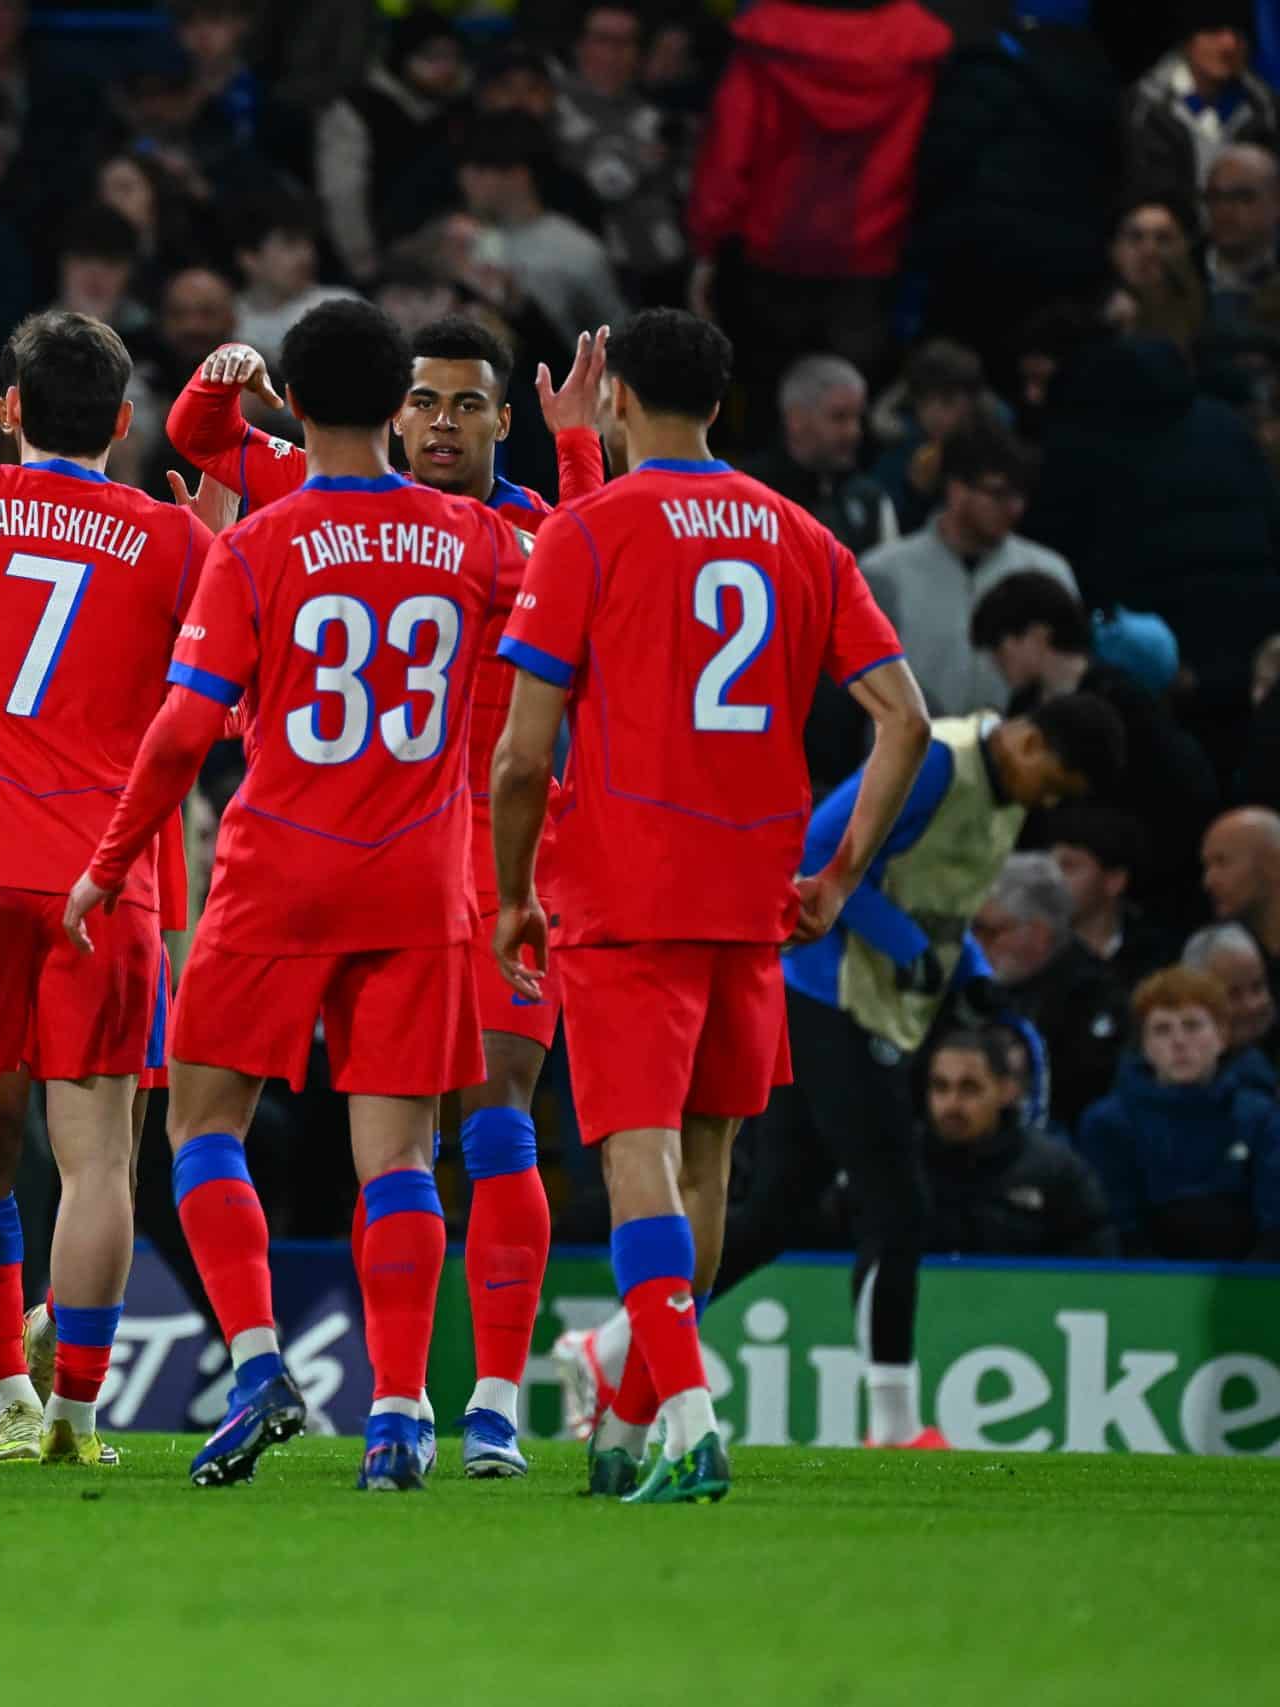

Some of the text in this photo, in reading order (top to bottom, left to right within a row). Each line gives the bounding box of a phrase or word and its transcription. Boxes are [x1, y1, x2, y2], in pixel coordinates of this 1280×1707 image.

[291, 520, 465, 576] ZAÏRE-EMERY
[660, 498, 779, 544] HAKIMI
[5, 552, 96, 718] 7
[285, 593, 463, 765] 33
[692, 558, 776, 733] 2
[517, 1294, 1280, 1456] ineke
